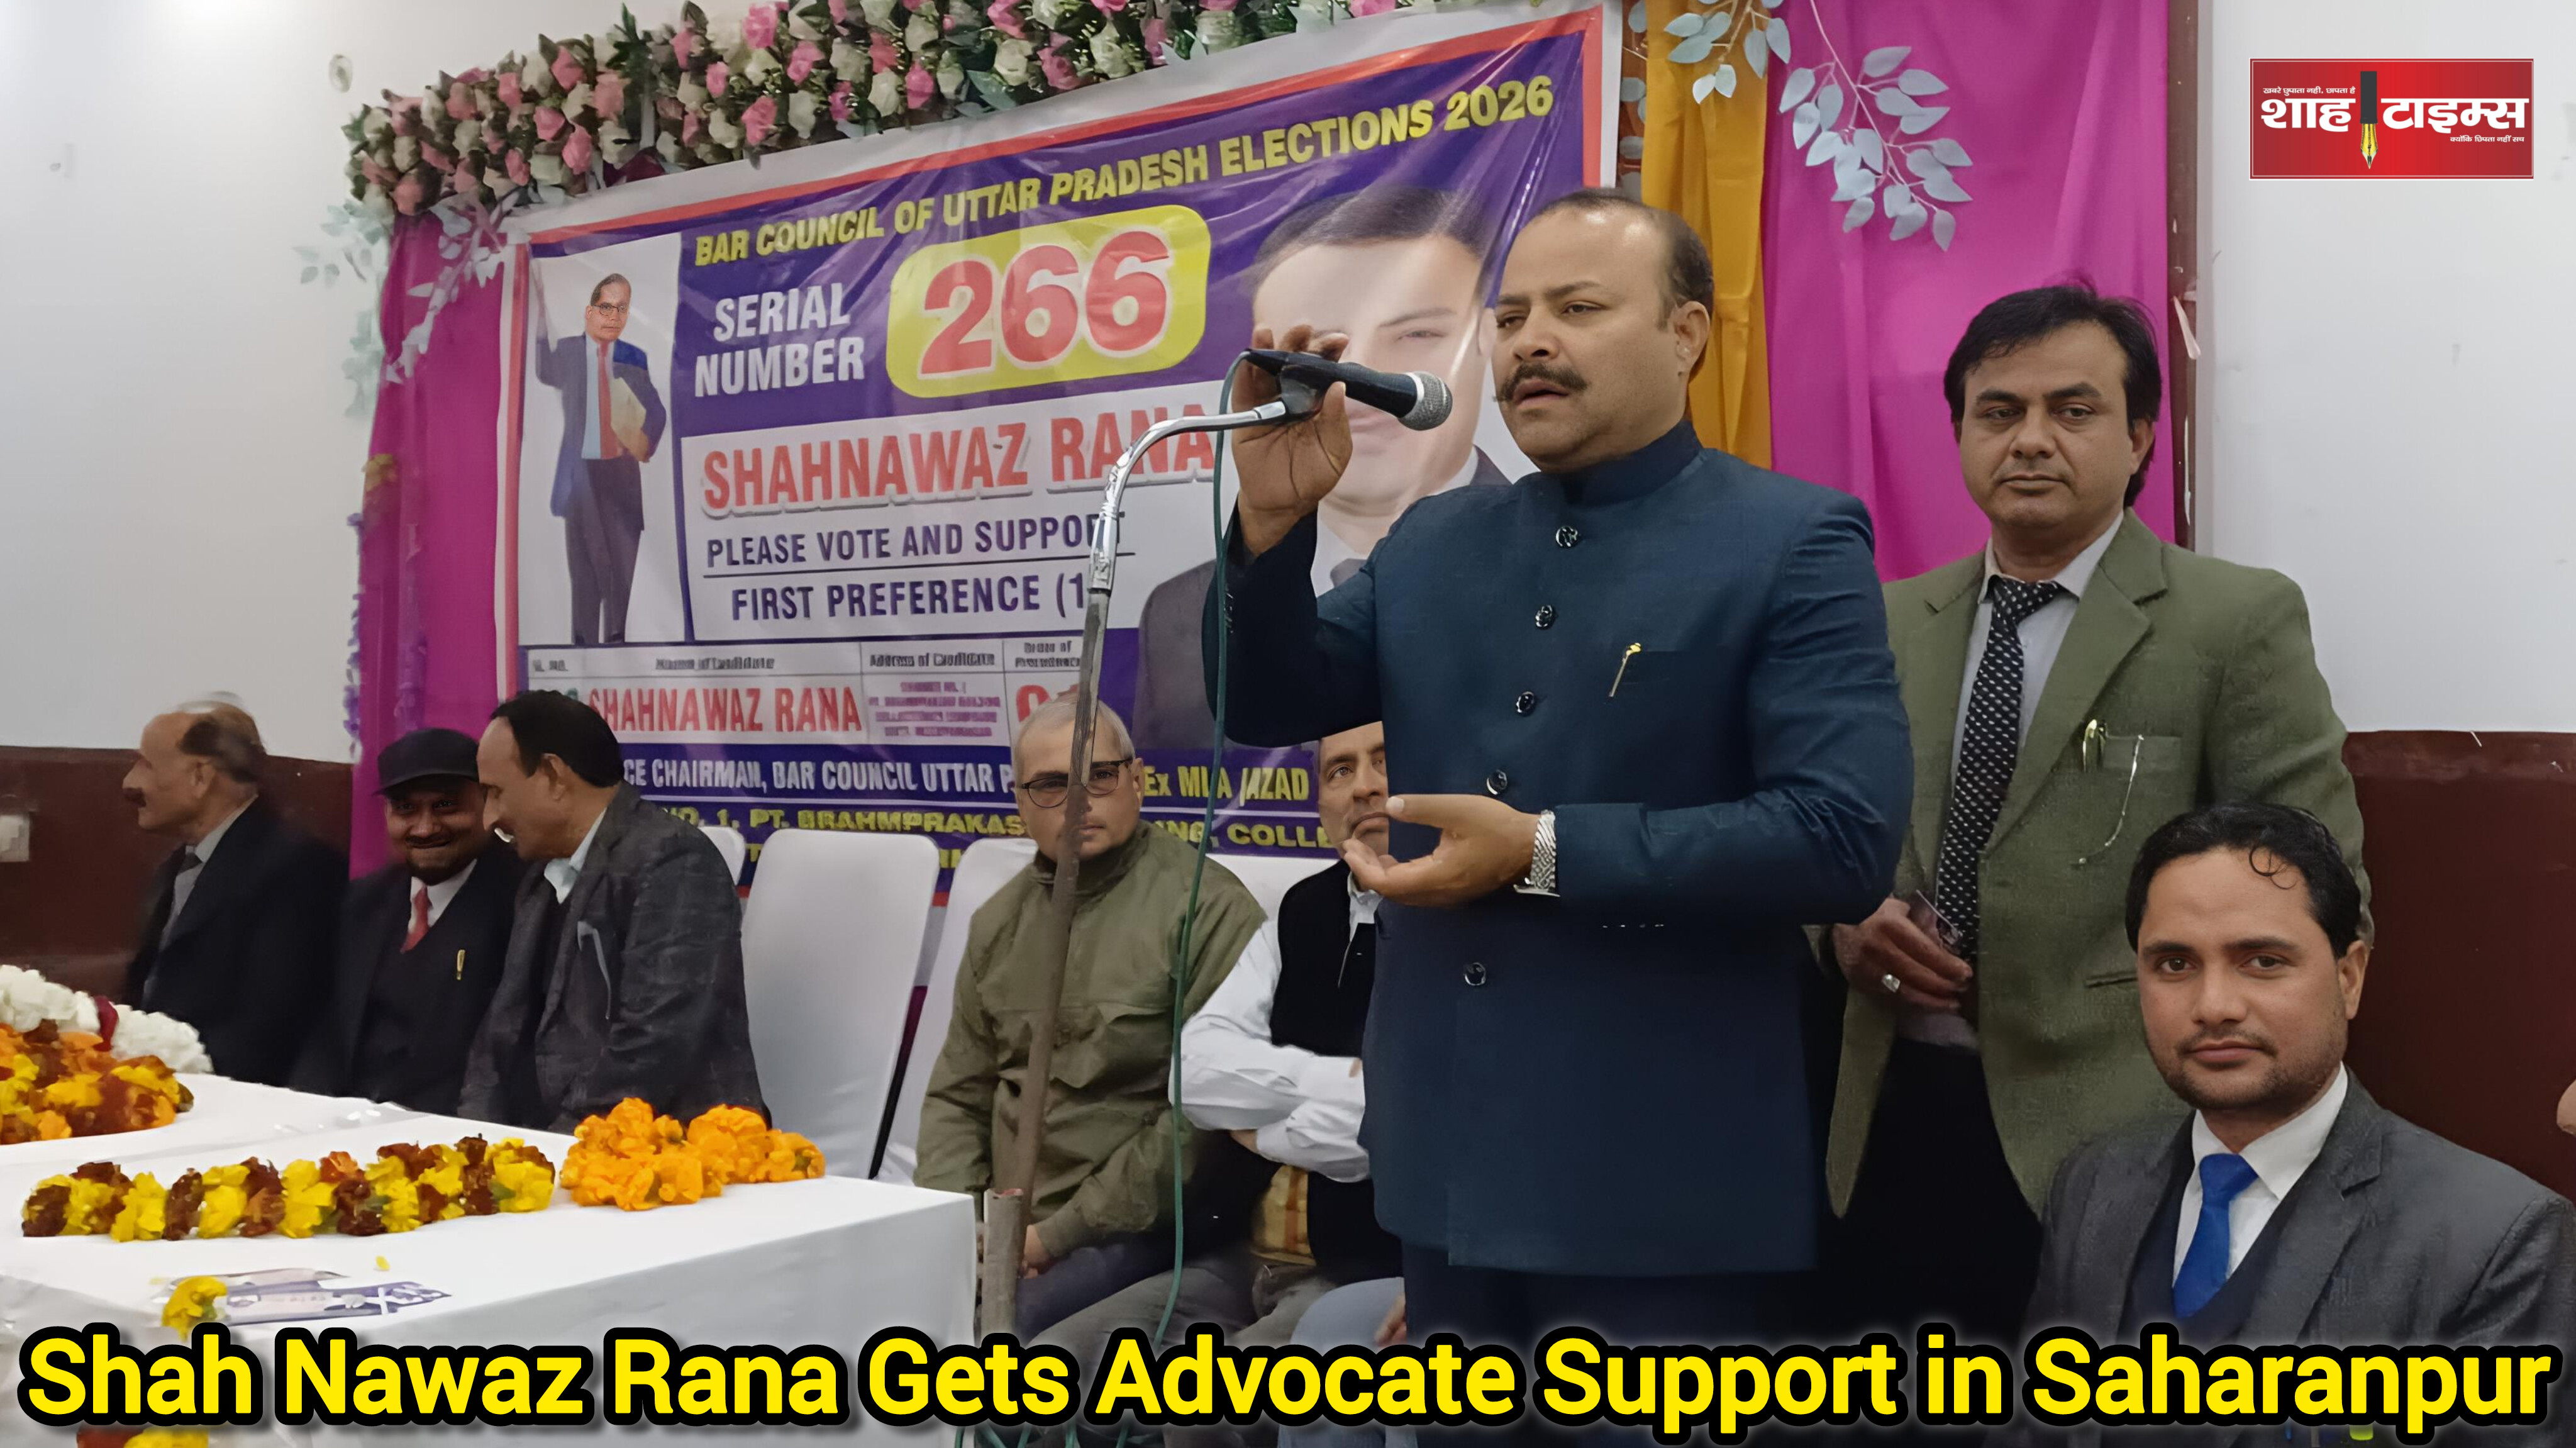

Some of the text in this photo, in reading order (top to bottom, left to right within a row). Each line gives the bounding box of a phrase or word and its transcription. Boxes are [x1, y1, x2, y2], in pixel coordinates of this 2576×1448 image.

[695, 75, 1553, 265] BAR COUNCIL OF UTTAR PRADESH ELECTIONS 2026
[713, 282, 850, 342] SERIAL
[920, 229, 1170, 376] 266
[694, 337, 865, 398] NUMBER
[703, 404, 1215, 510] SHAHNAWAZ RANA
[706, 533, 806, 568] PLEASE
[817, 527, 890, 561] VOTE
[902, 523, 963, 557] AND
[731, 586, 814, 621] FIRST
[827, 575, 1040, 618] PREFERENCE
[775, 686, 862, 732] RANA
[772, 761, 816, 789] BAR
[821, 760, 918, 791] COUNCIL
[921, 762, 995, 793] UTTAR
[1144, 766, 1172, 797] Ex
[797, 810, 1028, 836] BRAHMPRAKAS
